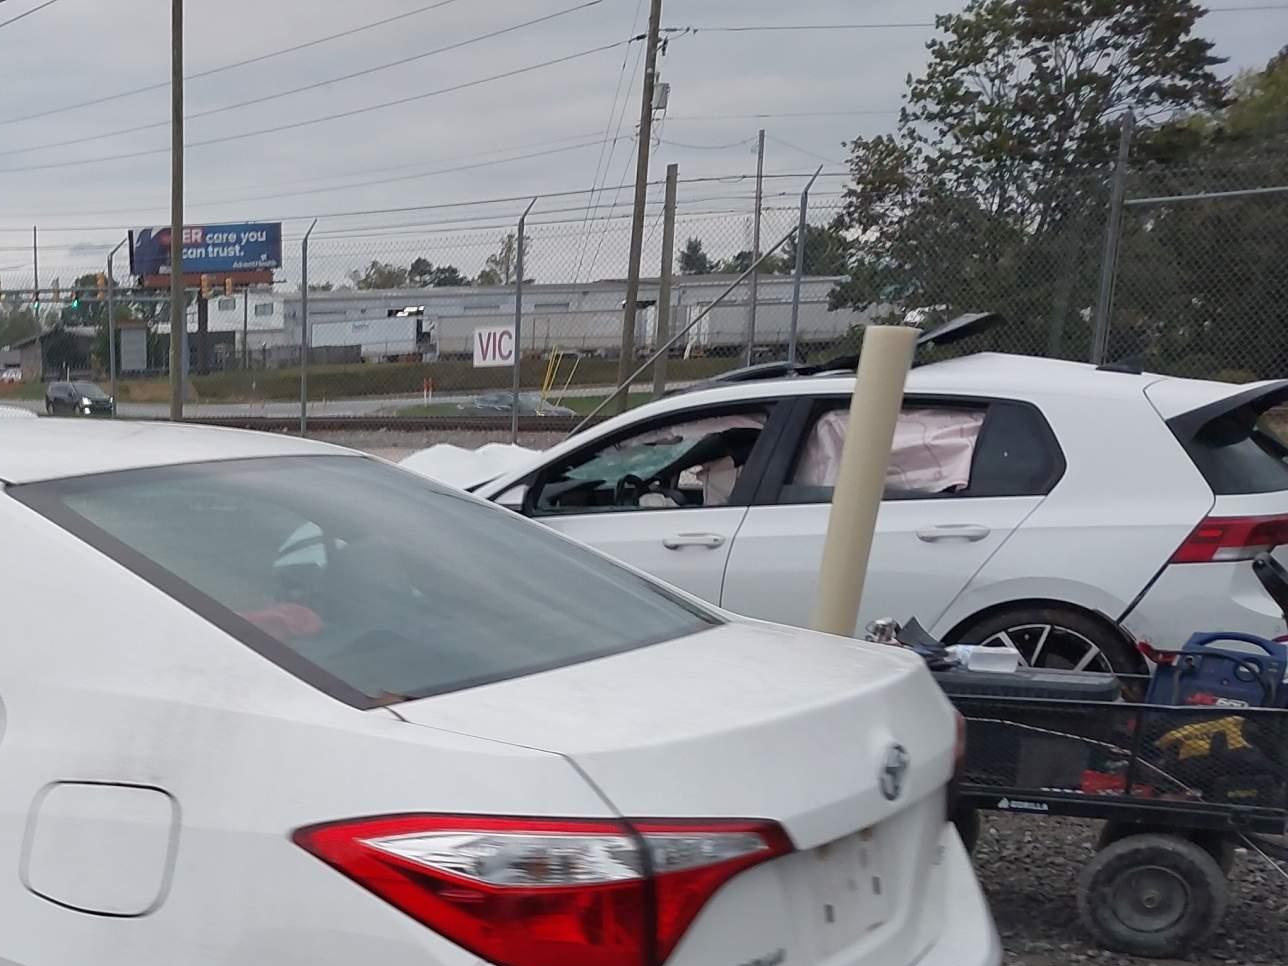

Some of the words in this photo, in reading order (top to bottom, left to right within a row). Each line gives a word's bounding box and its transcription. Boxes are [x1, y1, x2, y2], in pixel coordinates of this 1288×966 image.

[183, 229, 202, 243] ER
[206, 232, 236, 244] care
[240, 231, 266, 245] you
[183, 247, 205, 259] can
[207, 244, 244, 257] trust.
[478, 330, 513, 361] VIC
